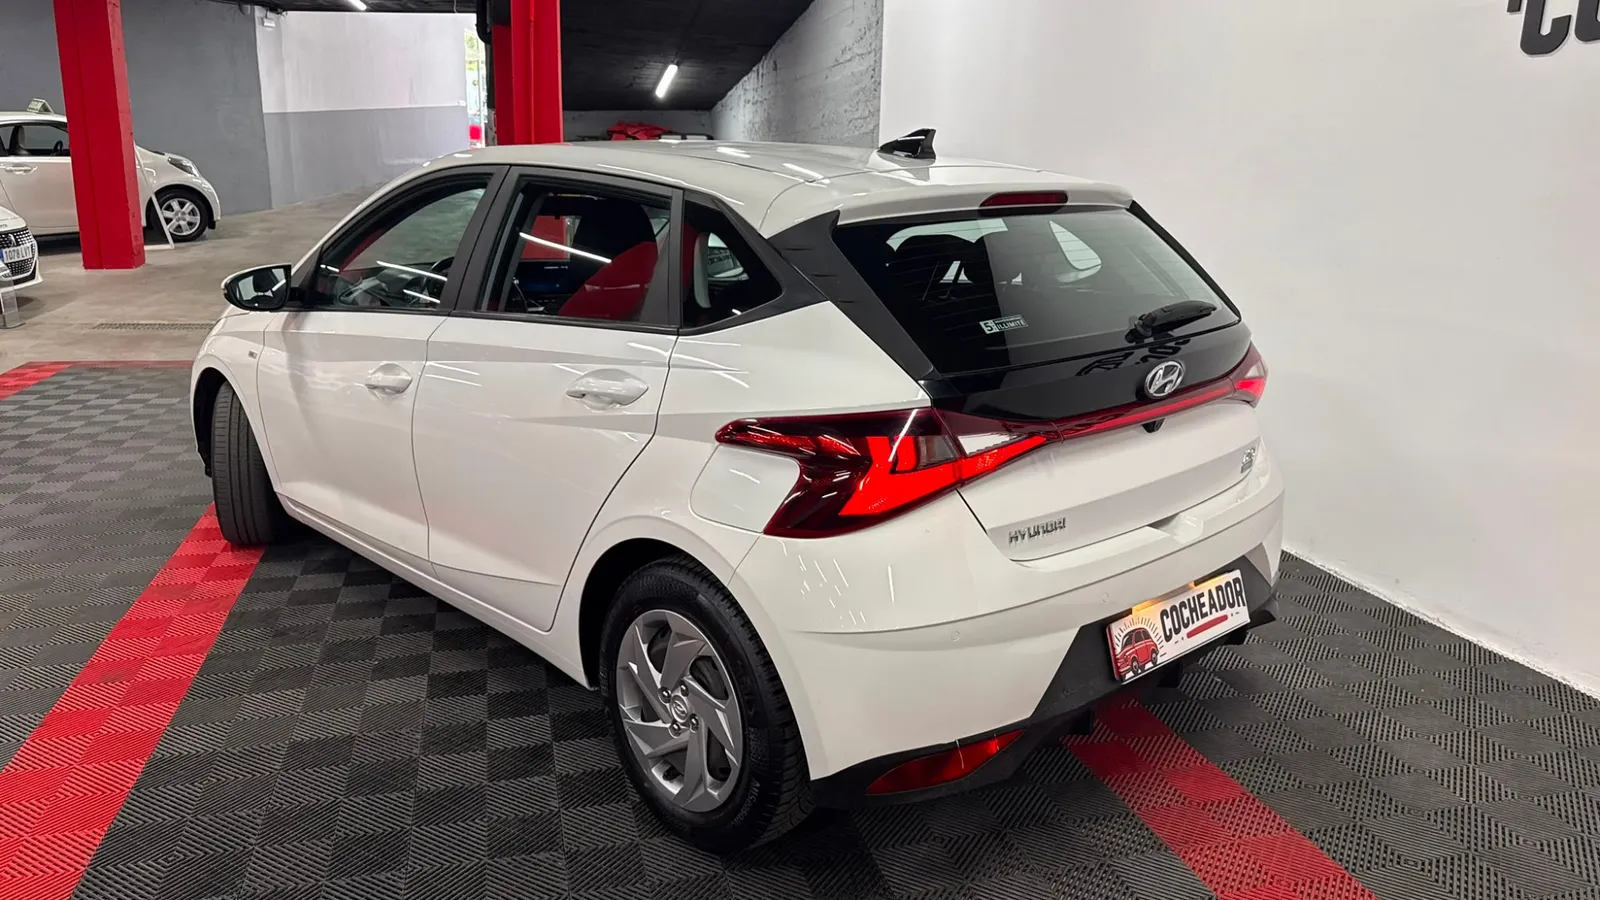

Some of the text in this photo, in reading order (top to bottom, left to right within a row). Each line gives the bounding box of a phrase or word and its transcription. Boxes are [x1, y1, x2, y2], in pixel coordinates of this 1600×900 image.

[983, 321, 994, 332] 5
[1008, 516, 1066, 544] HYUNDAI
[1160, 576, 1246, 643] COCHEADOR
